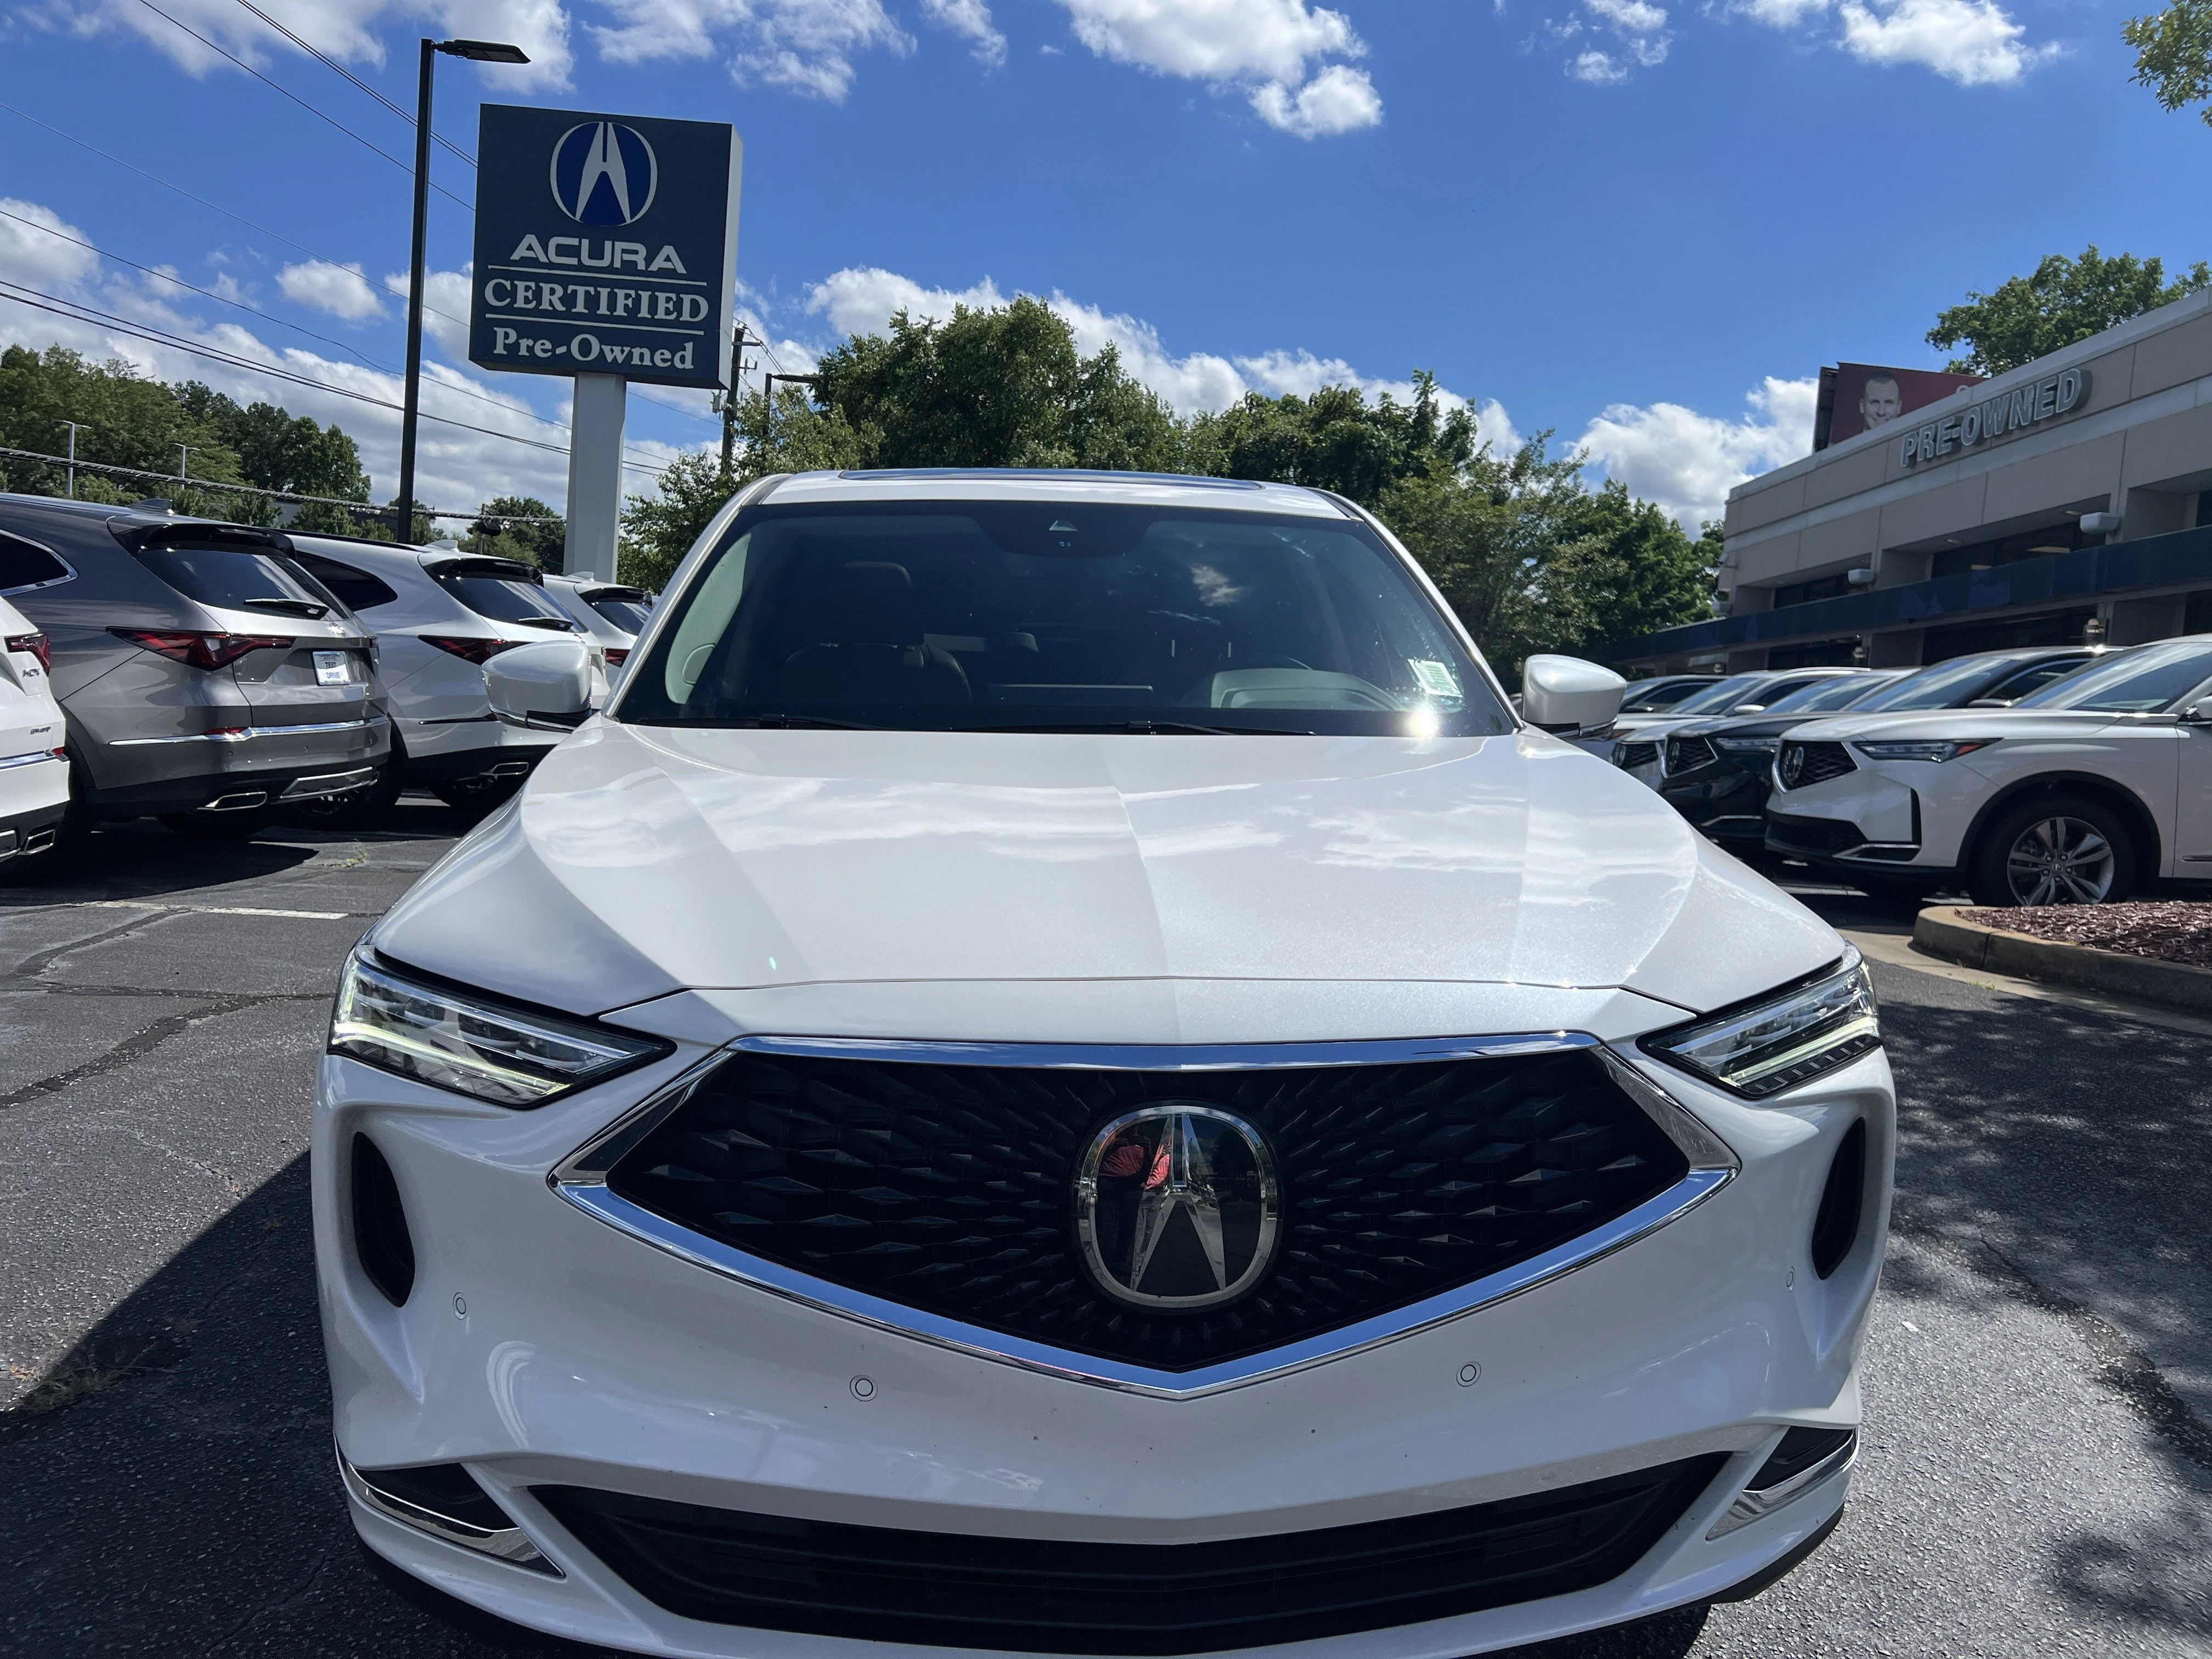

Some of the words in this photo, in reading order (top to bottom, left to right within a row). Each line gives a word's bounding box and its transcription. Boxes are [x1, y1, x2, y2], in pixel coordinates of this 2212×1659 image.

[510, 234, 687, 274] ACURA
[484, 279, 709, 322] CERTIFIED
[493, 327, 695, 369] Pre-Owned
[1900, 368, 2083, 467] PRE-OWNED
